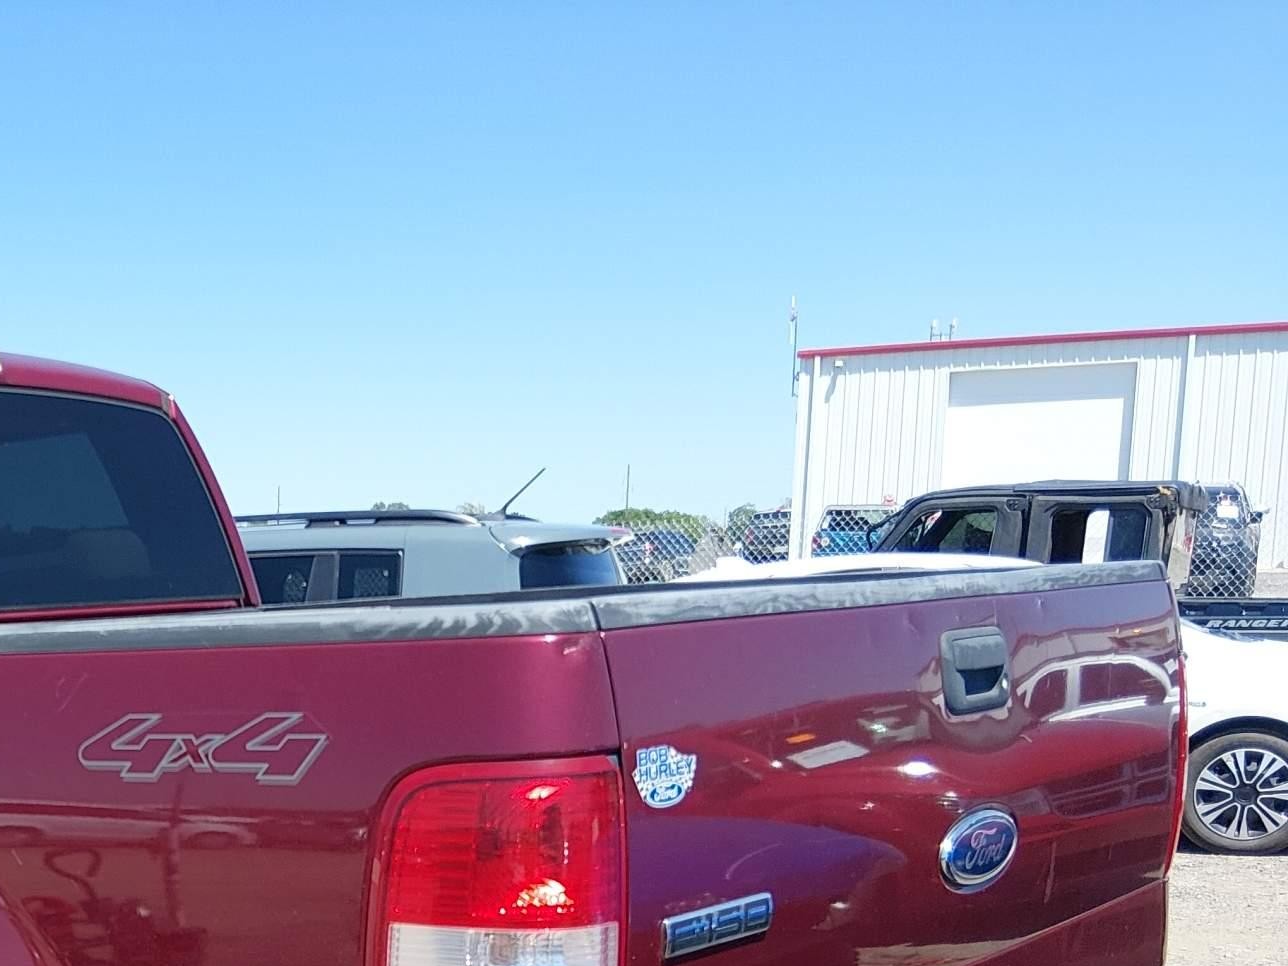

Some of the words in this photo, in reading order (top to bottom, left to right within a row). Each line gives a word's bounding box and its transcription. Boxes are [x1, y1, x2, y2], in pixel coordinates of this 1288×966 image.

[77, 712, 330, 786] 4x4
[638, 747, 669, 767] BOB
[638, 757, 694, 783] HURLEY
[965, 826, 1007, 870] Ford
